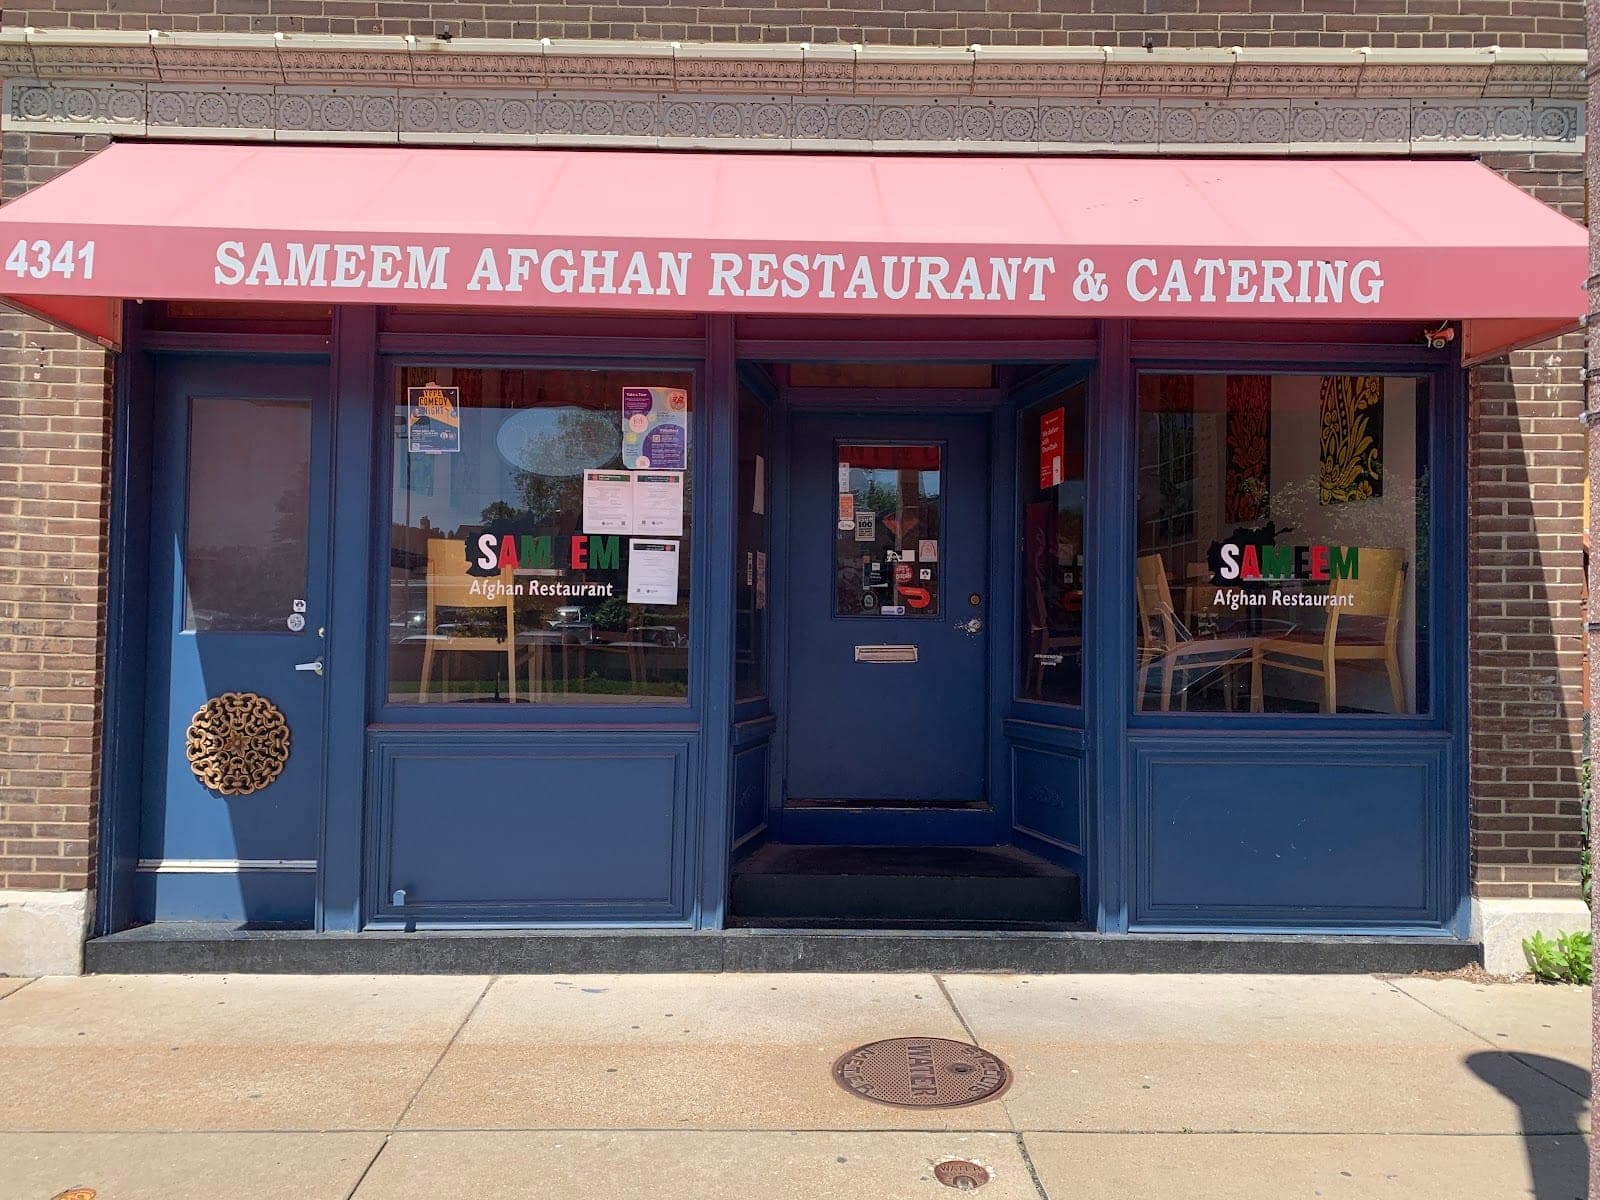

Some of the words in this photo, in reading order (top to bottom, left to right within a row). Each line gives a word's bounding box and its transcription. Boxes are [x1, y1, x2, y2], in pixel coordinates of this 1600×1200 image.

[5, 239, 95, 280] 4341
[214, 241, 451, 290] SAMEEM
[466, 247, 693, 296] AFGHAN
[707, 253, 1055, 302] RESTAURANT
[1072, 257, 1109, 303] &
[1126, 258, 1385, 305] CATERING
[419, 397, 448, 406] COMEDY
[1220, 543, 1359, 581] SAMEEM
[469, 579, 524, 600] Afghan
[528, 579, 614, 598] Restaurant
[1213, 588, 1267, 611] Afghan
[1271, 589, 1355, 607] Restaurant
[843, 1047, 876, 1096] METER
[907, 1044, 938, 1097] WATER
